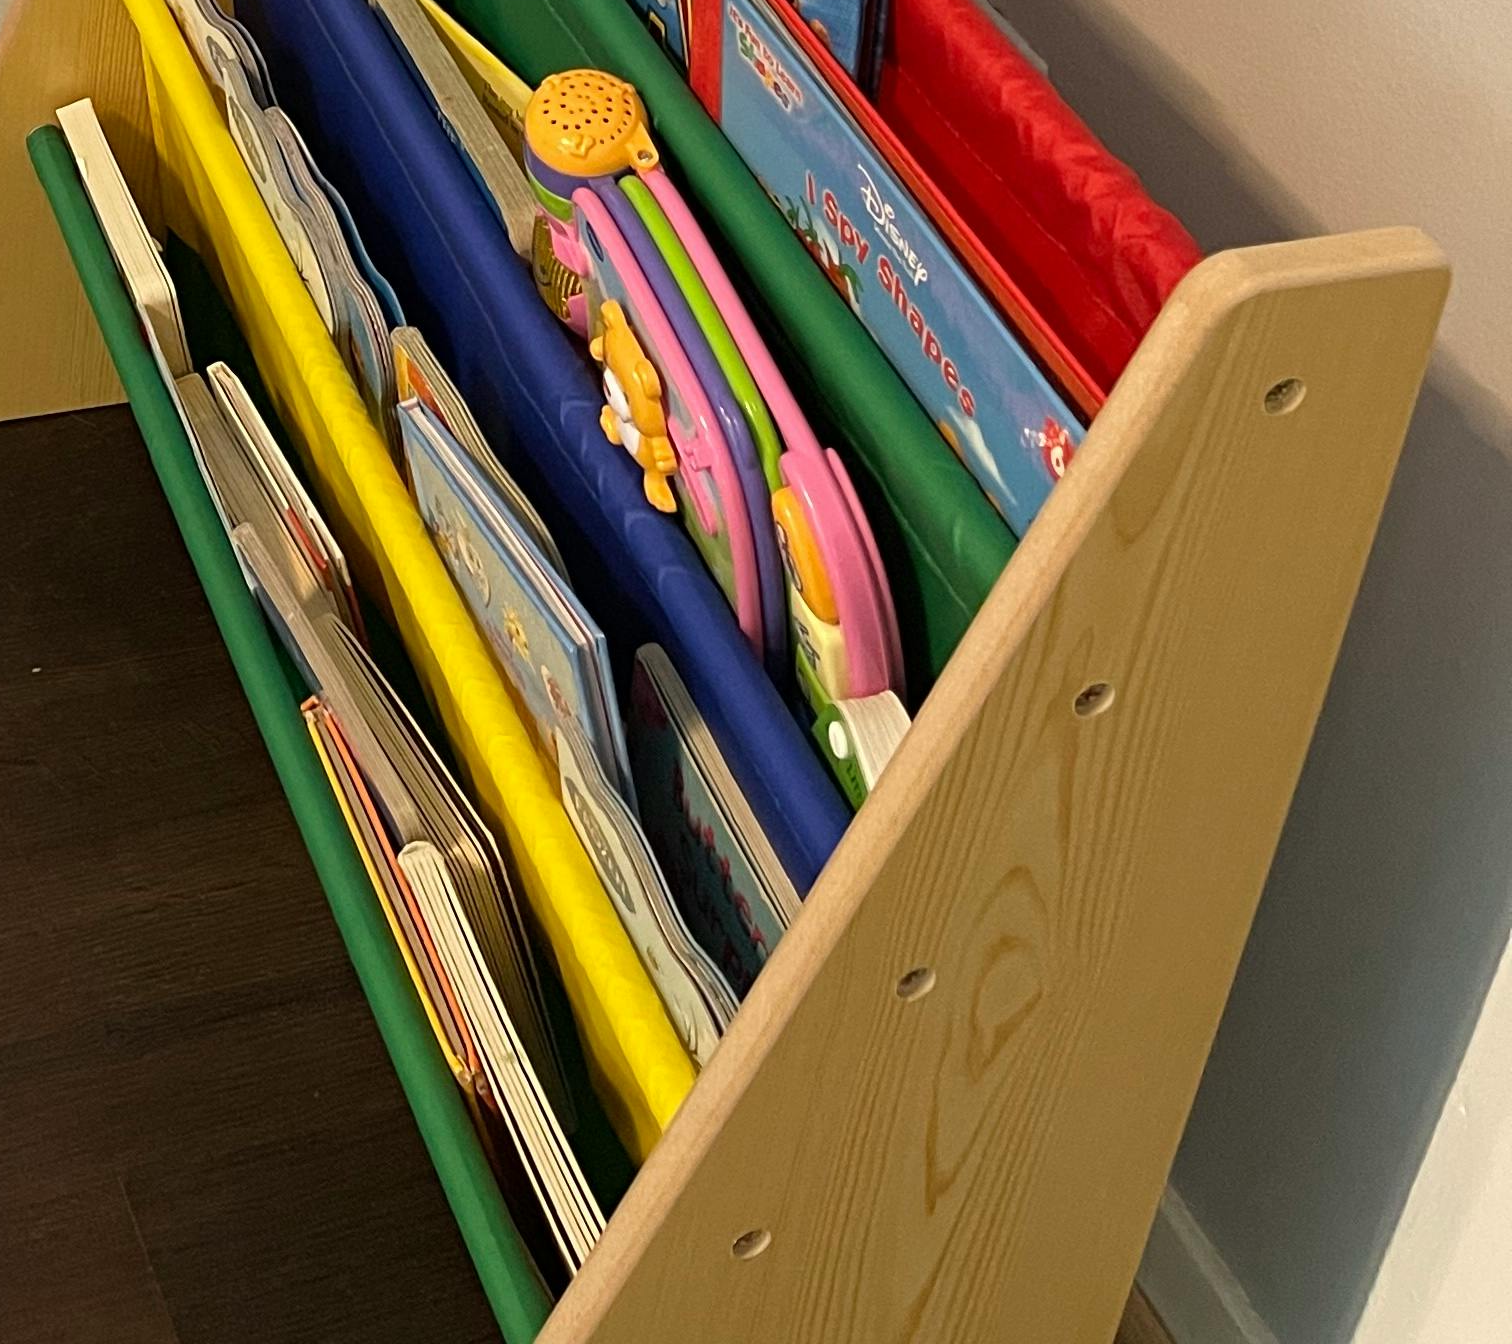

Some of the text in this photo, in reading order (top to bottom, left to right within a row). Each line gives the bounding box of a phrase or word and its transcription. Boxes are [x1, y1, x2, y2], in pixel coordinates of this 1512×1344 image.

[806, 172, 976, 418] I Spy Shapes
[857, 163, 928, 287] Disney
